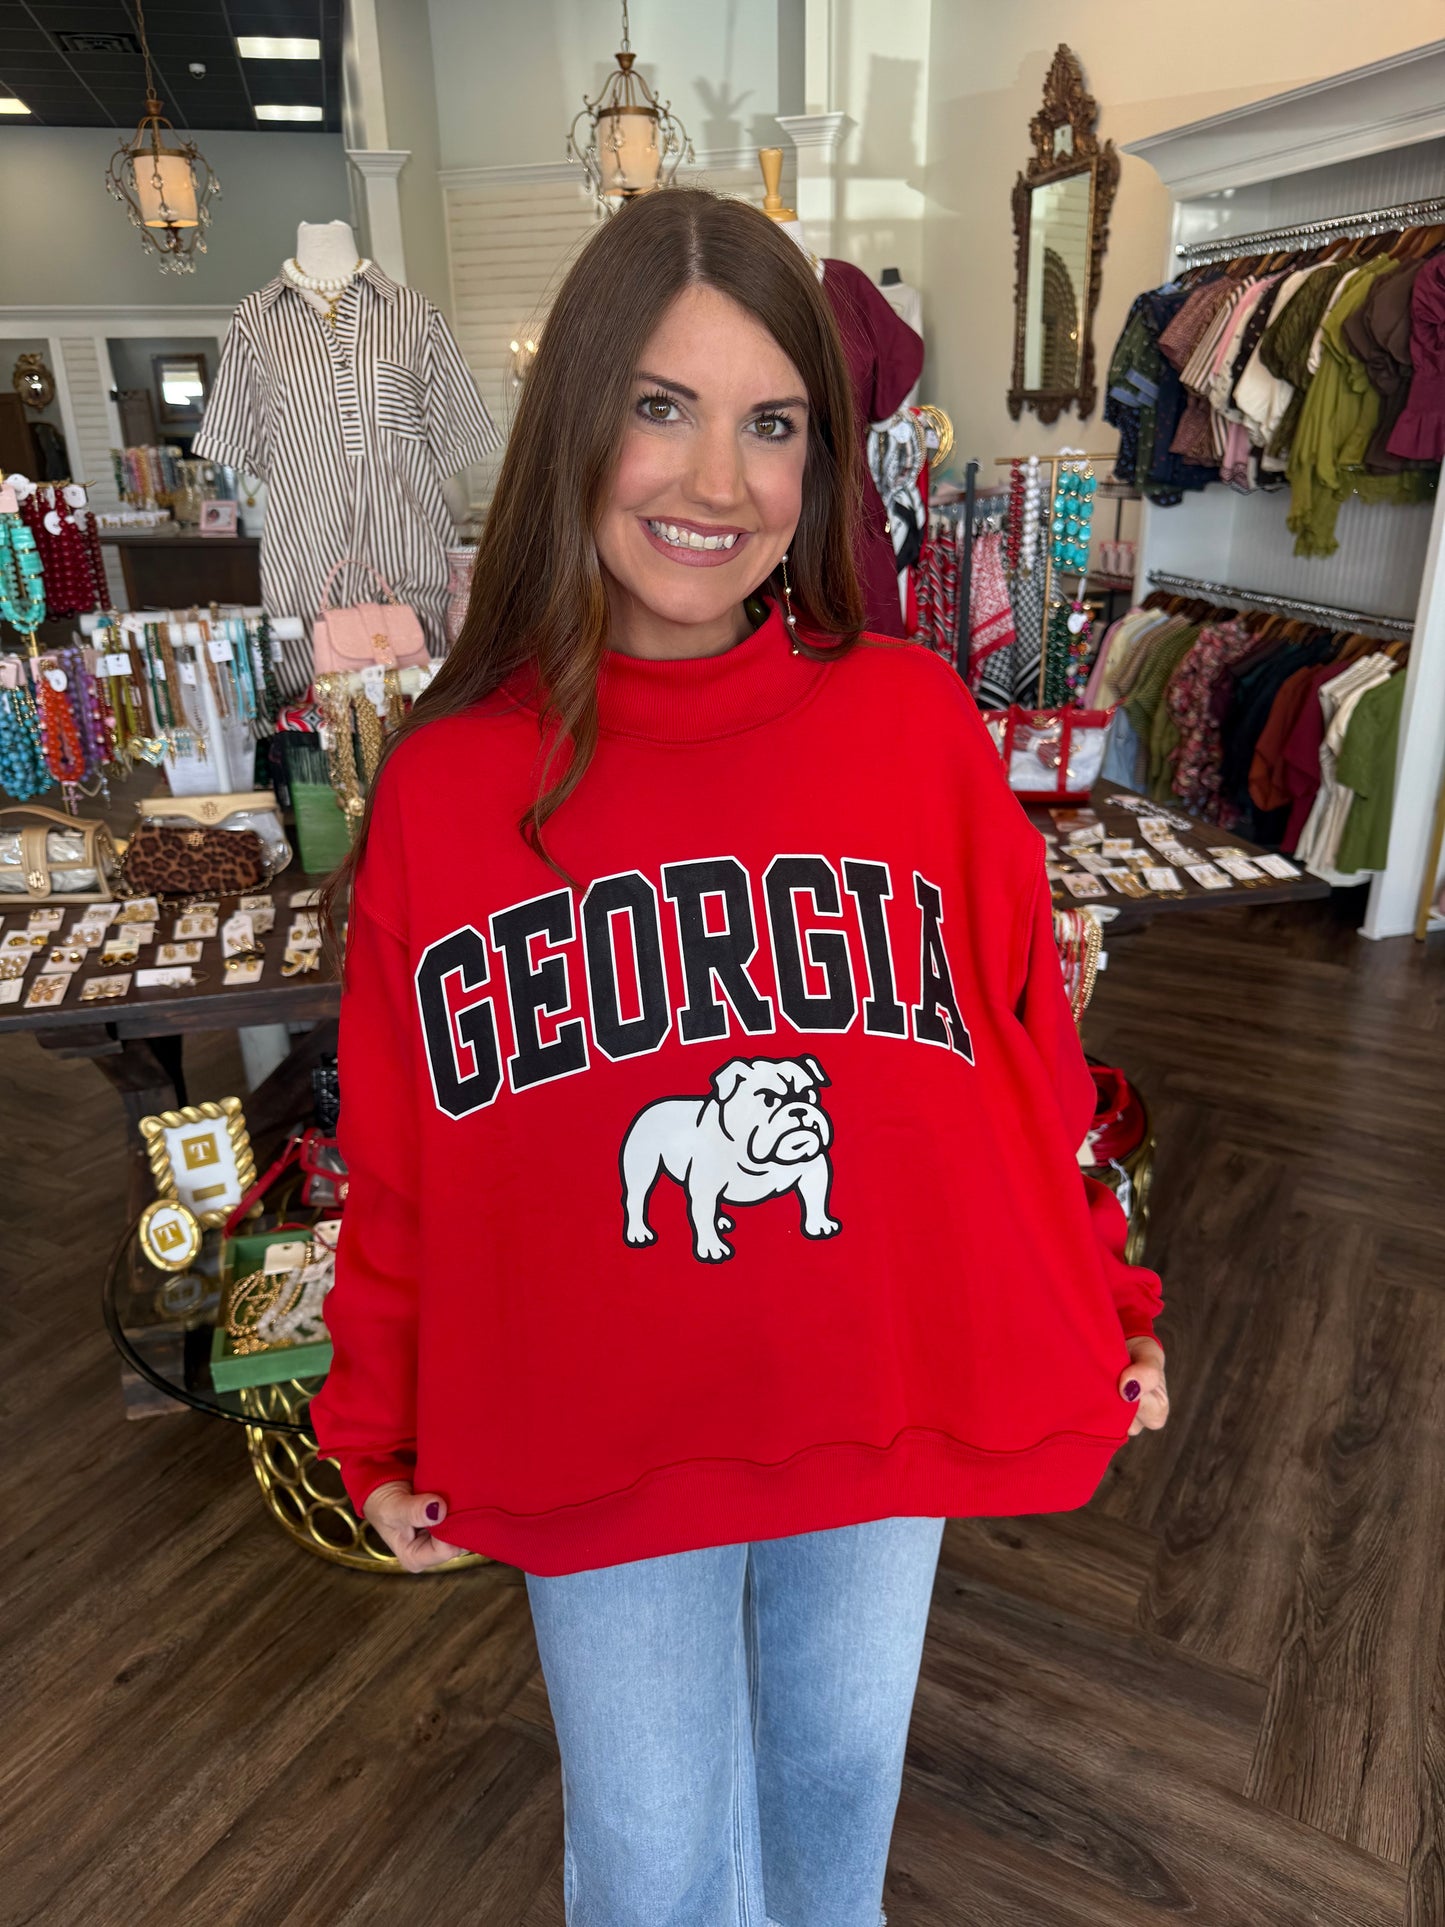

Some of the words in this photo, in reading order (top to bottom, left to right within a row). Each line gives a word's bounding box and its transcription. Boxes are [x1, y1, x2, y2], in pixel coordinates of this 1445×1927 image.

[414, 854, 975, 1120] GEORGIA
[188, 1141, 211, 1161] T
[157, 1223, 178, 1243] T
